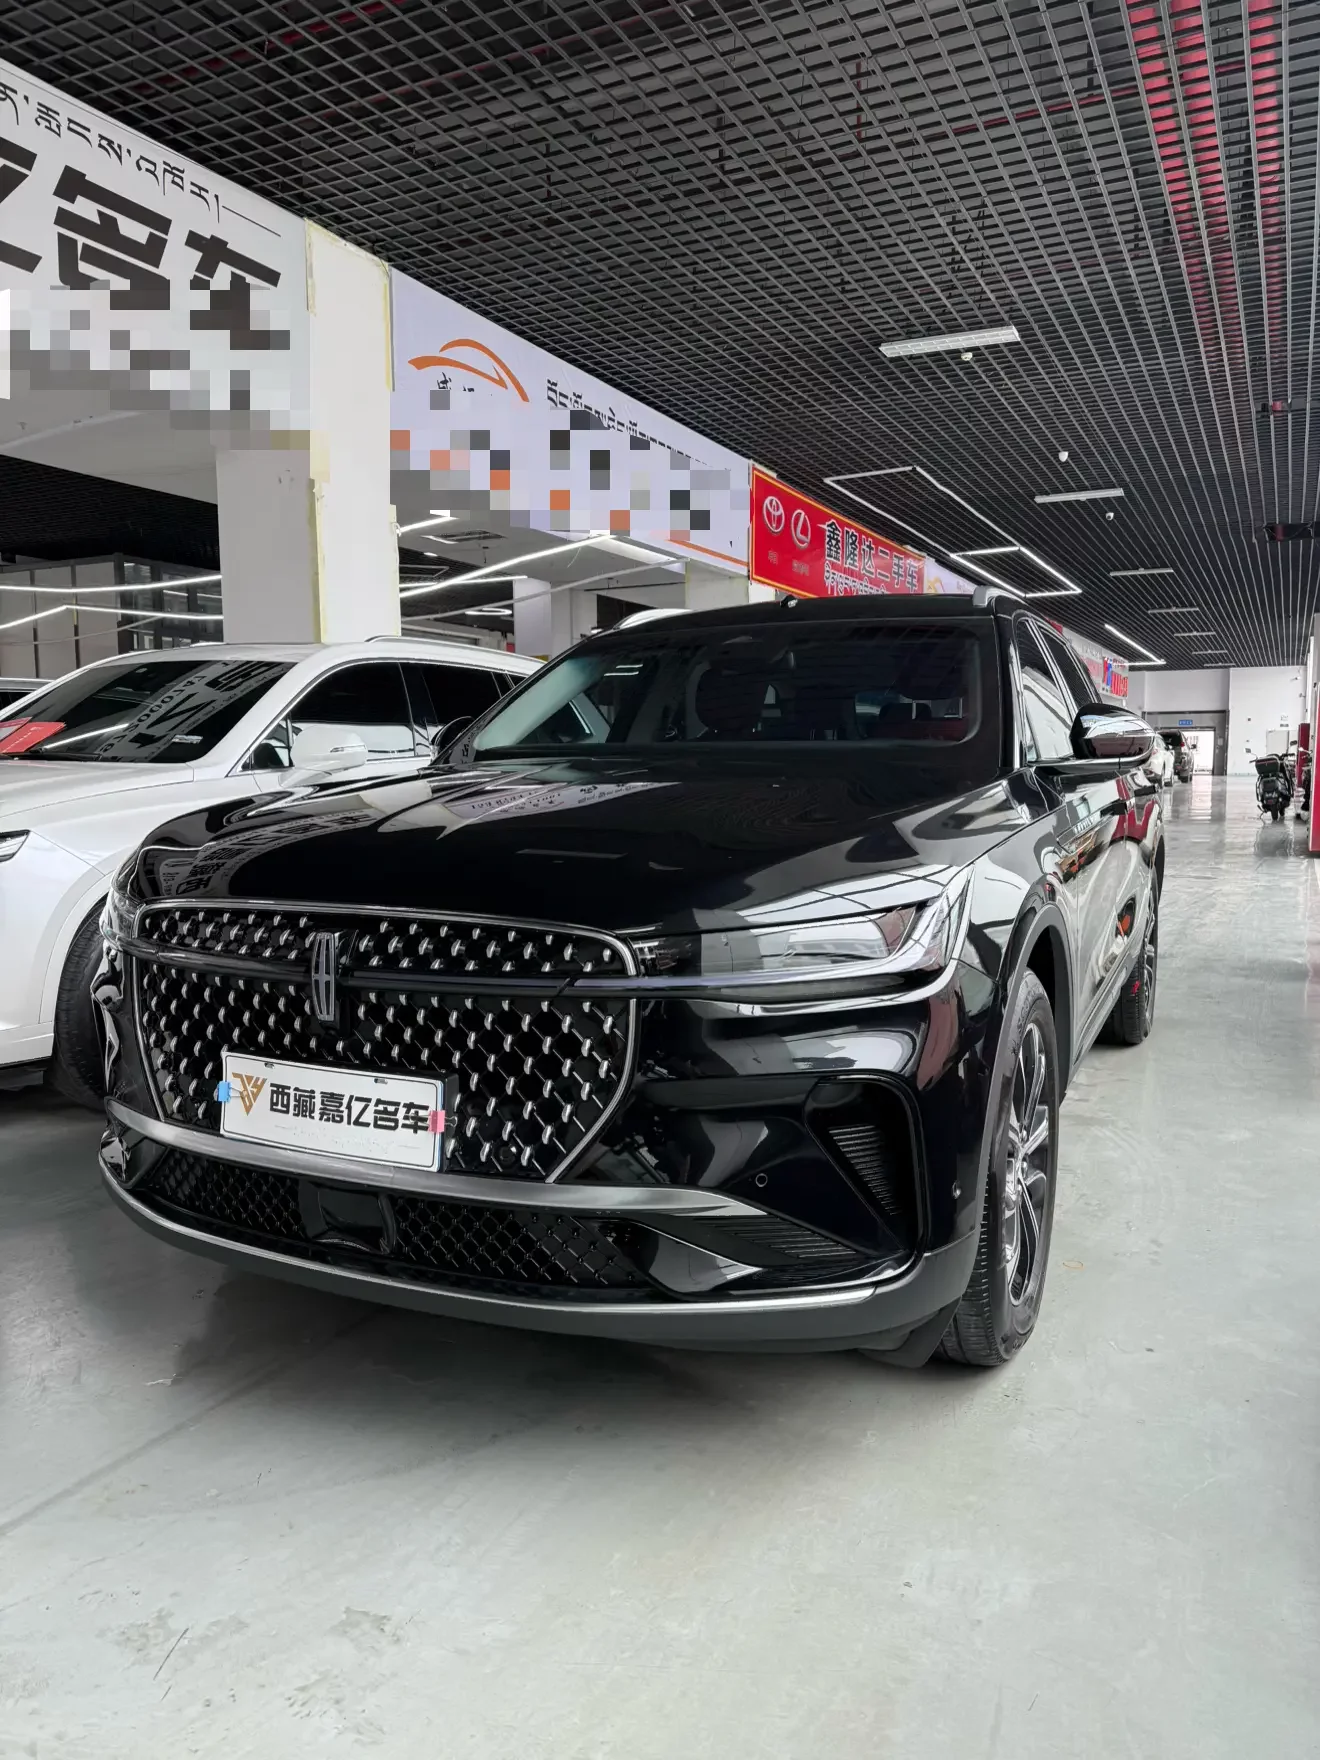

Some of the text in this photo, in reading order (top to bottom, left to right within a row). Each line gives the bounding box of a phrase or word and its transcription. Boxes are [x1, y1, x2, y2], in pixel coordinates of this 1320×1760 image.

[825, 519, 919, 594] 鑫隆达二手车
[269, 1082, 430, 1134] 西藏嘉亿名车
